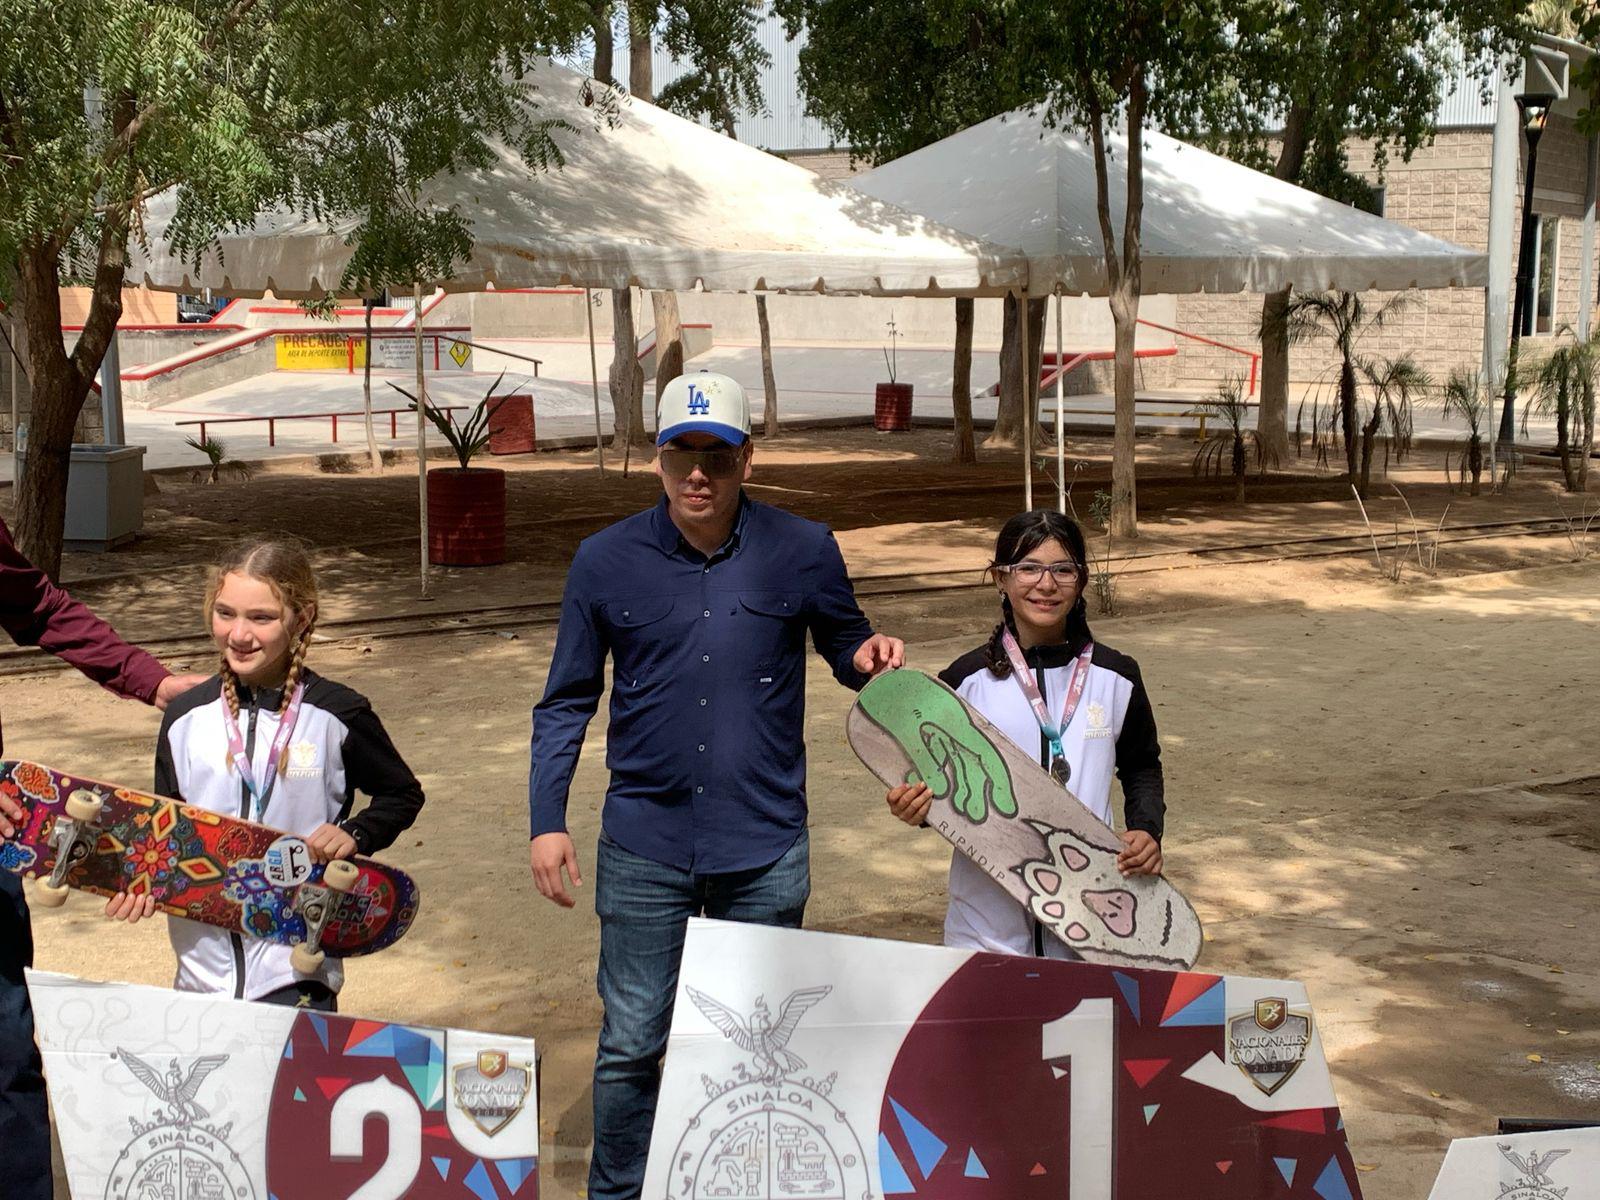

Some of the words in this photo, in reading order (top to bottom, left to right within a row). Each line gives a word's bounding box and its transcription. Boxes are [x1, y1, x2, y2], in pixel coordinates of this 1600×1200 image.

[687, 383, 710, 415] LA
[267, 849, 285, 881] ARGO
[937, 820, 1007, 881] RIPNDIP
[1230, 1034, 1309, 1049] NACIONALES
[1230, 1045, 1307, 1066] CONADE
[726, 1090, 815, 1115] SINALOA
[1041, 997, 1115, 1200] 1
[148, 1131, 215, 1153] SINALOA
[330, 1075, 422, 1200] 2
